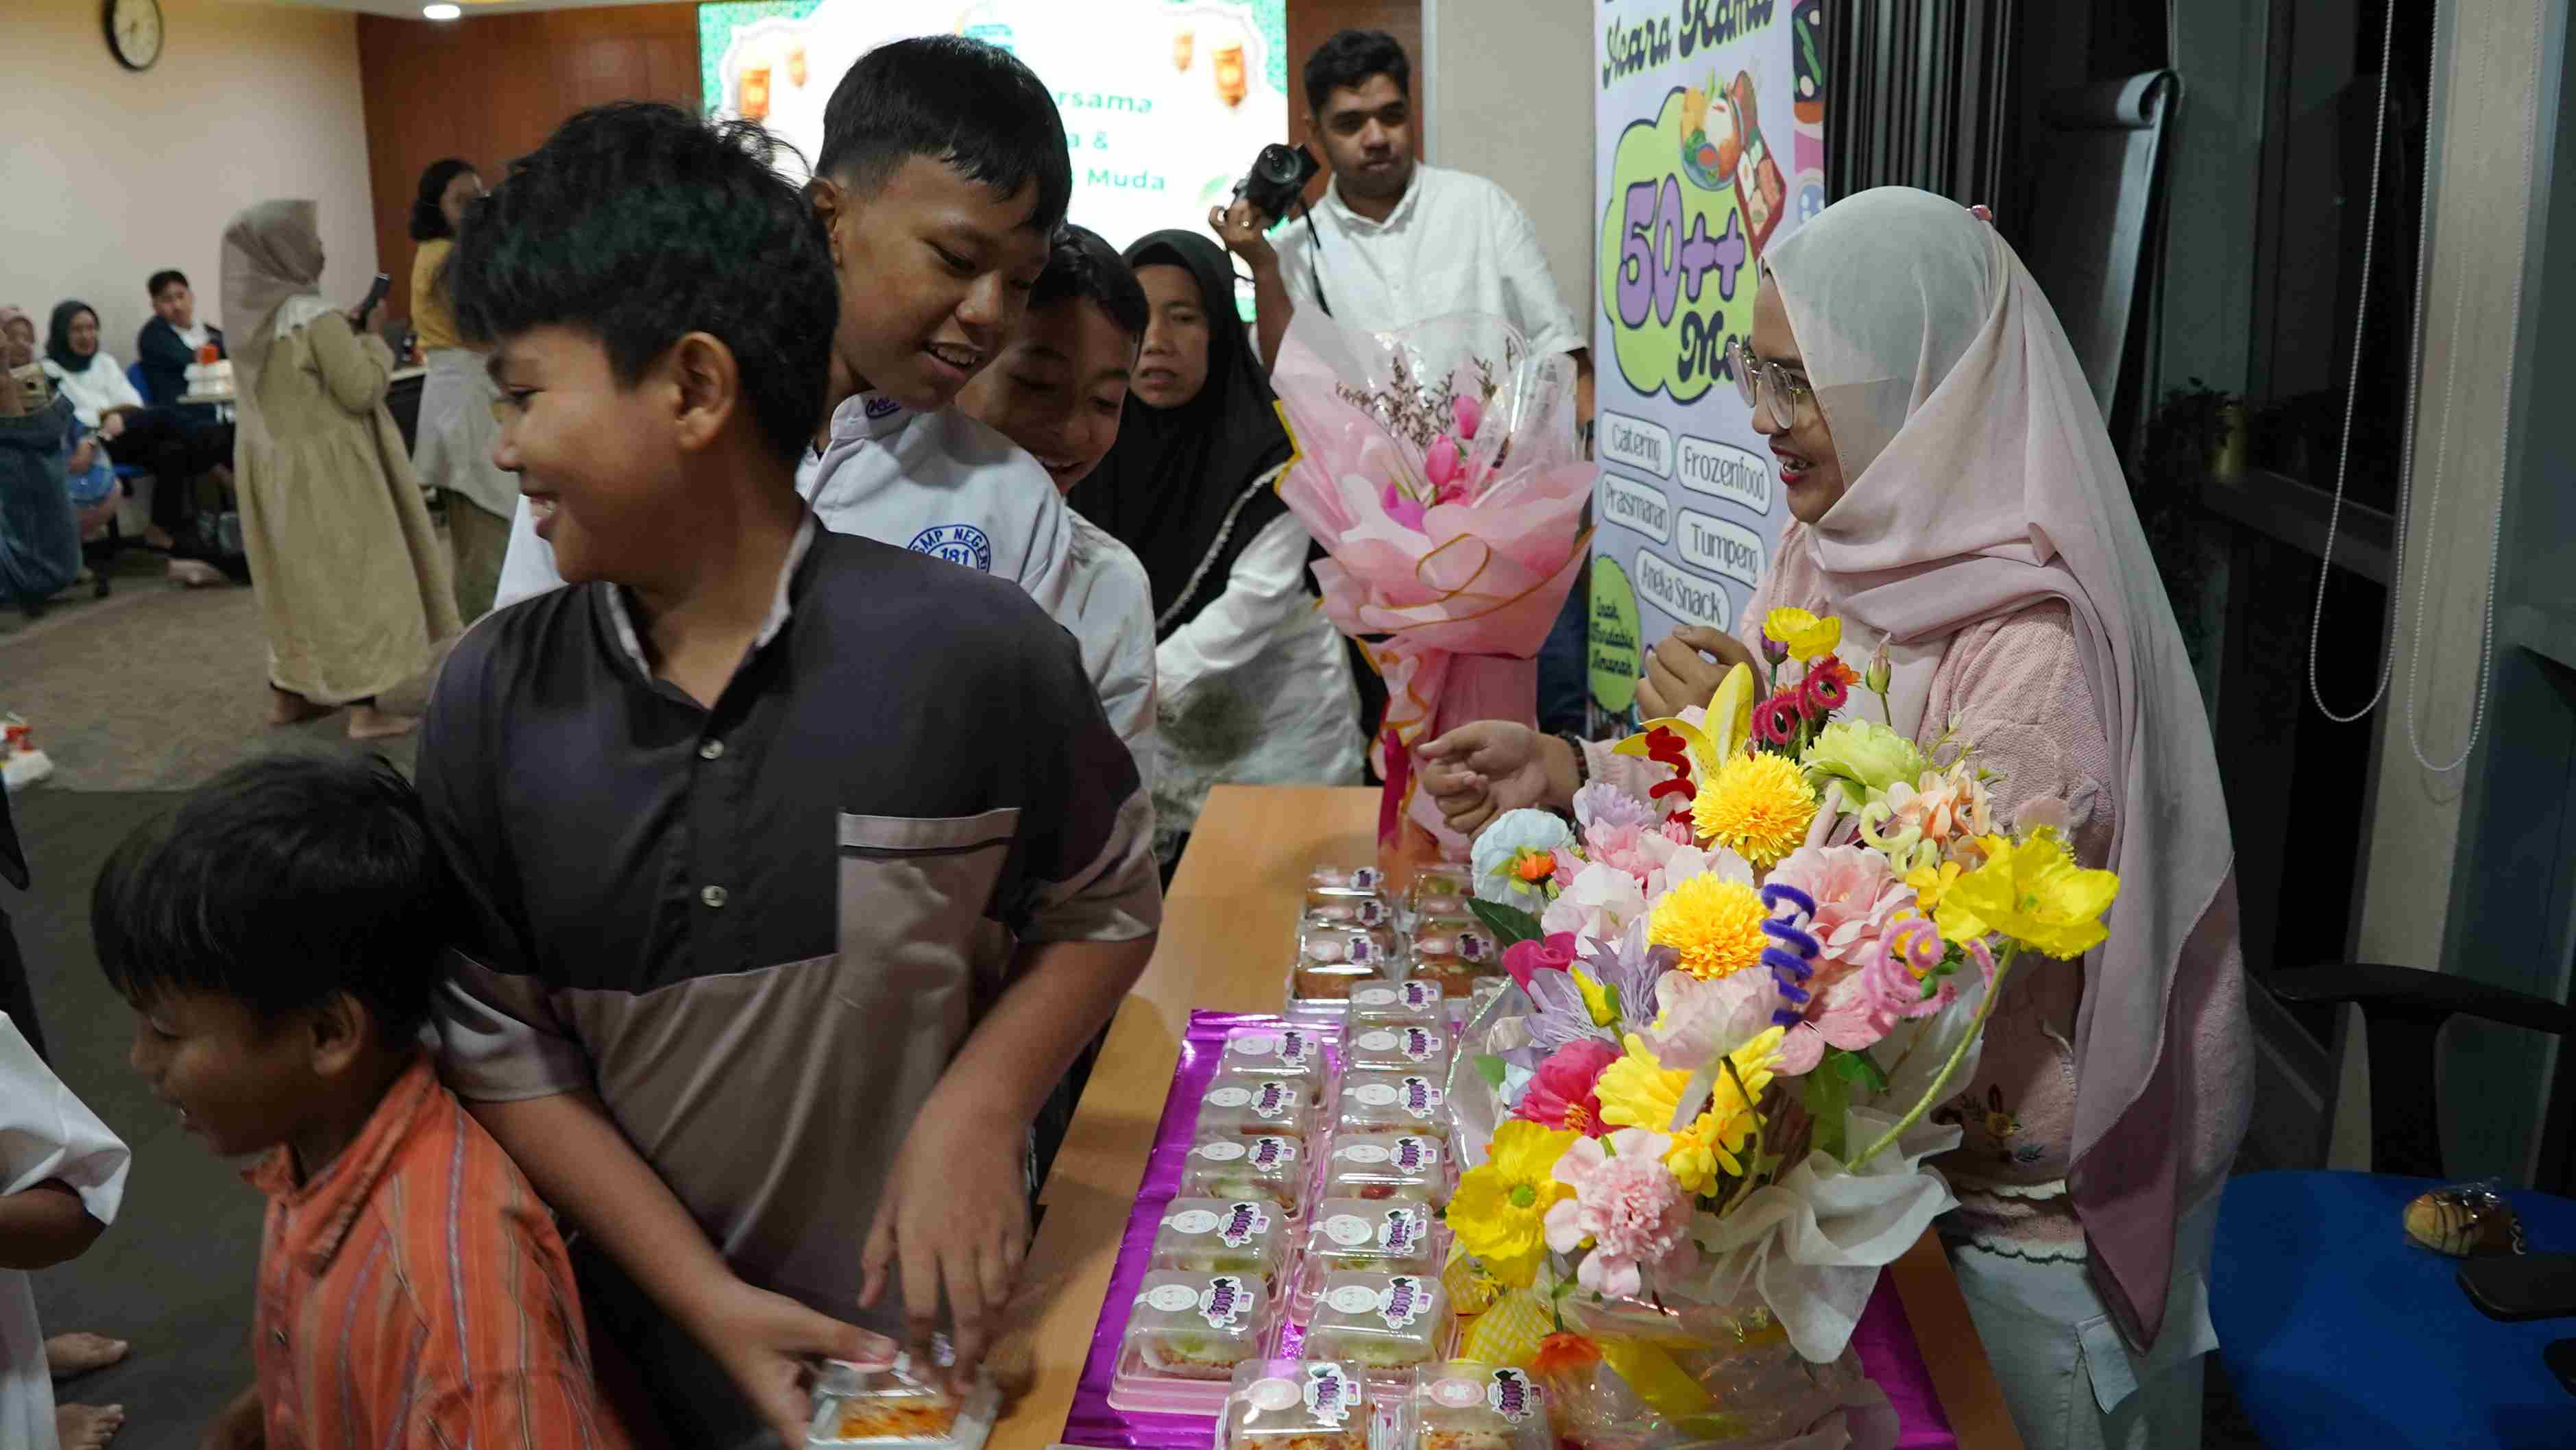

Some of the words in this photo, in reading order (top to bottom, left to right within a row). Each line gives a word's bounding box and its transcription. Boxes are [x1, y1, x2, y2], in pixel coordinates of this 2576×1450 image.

[1058, 91, 1152, 114] rsama
[1087, 169, 1165, 190] Muda
[1616, 173, 1745, 330] 50++
[1612, 423, 1662, 471] Catering
[1684, 445, 1765, 502] Frozenfood
[1605, 482, 1667, 532] Prasmanan
[954, 528, 988, 570] NEGER
[1690, 522, 1758, 582] Tumpeng
[1675, 577, 1721, 625] Snack
